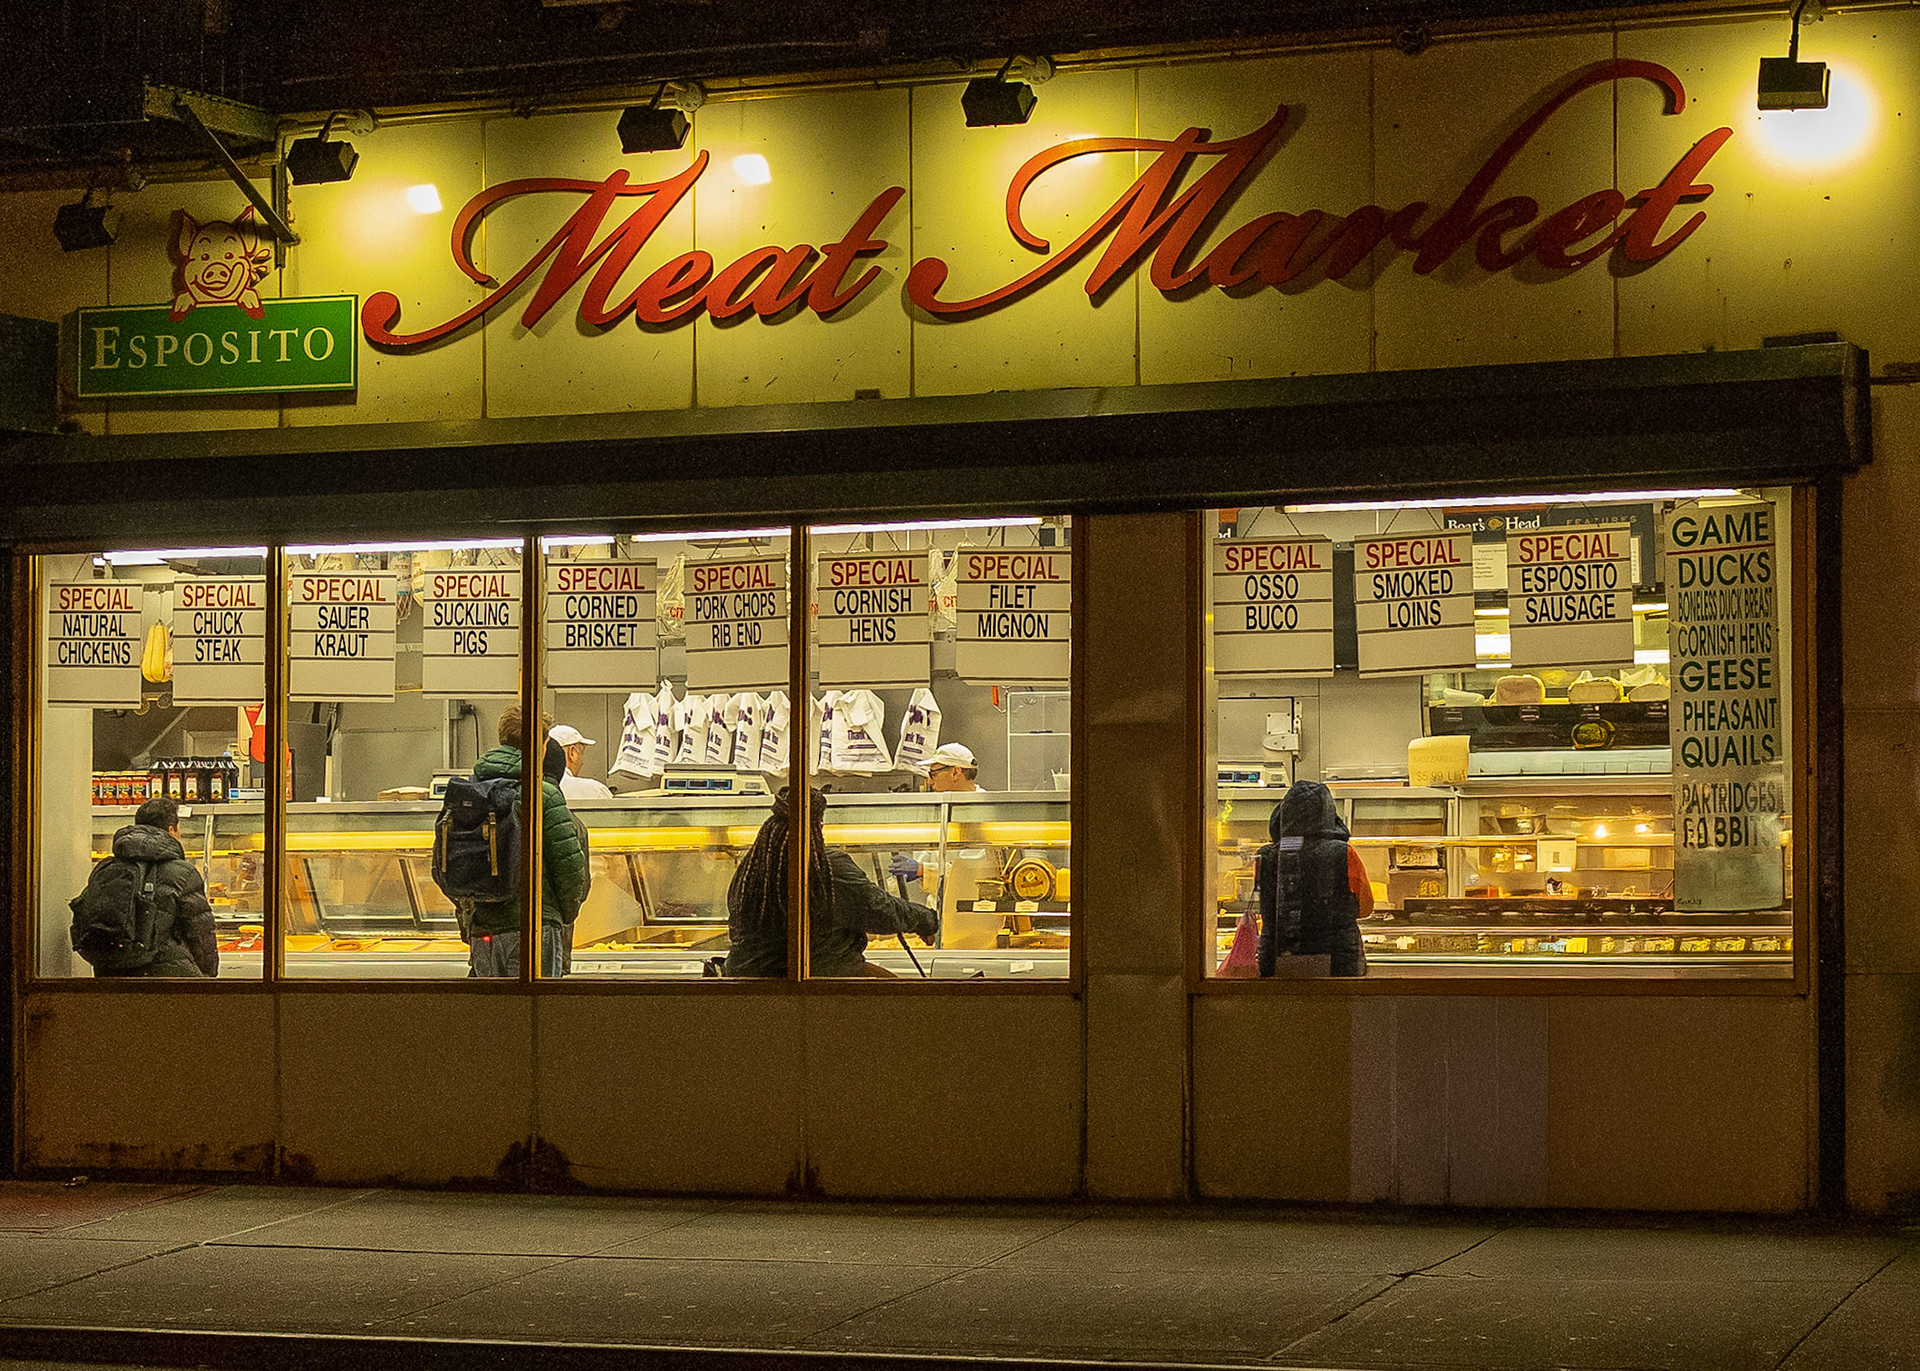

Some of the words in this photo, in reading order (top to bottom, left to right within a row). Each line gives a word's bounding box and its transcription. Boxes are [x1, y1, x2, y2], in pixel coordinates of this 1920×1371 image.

[362, 150, 906, 346] Meat
[906, 58, 1733, 314] Market
[90, 326, 335, 370] ESPOSITO
[1506, 515, 1540, 530] Head
[1672, 511, 1768, 547] GAME
[1225, 545, 1320, 571] SPECIAL
[1366, 539, 1460, 568] SPECIAL
[1519, 534, 1619, 564] SPECIAL
[558, 568, 645, 591] SPECIAL
[694, 564, 776, 592] SPECIAL
[830, 560, 920, 586] SPECIAL
[968, 556, 1059, 580] SPECIAL
[1522, 563, 1618, 593] ESPOSITO
[1678, 552, 1771, 588] DUCKS
[183, 585, 256, 606] SPECIAL
[302, 578, 386, 602] SPECIAL
[433, 575, 510, 598] SPECIAL
[990, 584, 1036, 609] FILET
[1245, 574, 1298, 600] OSSO
[1373, 570, 1453, 600] SMOKED
[60, 588, 133, 610] SPECIAL
[566, 596, 638, 619] CORNED
[696, 596, 728, 620] PORK
[734, 592, 776, 618] CHOPS
[834, 589, 912, 614] CORNISH
[1526, 594, 1616, 624] SAUSAGE
[1678, 590, 1717, 622] BONELESS
[1720, 588, 1742, 620] DUCK
[1744, 587, 1773, 618] BREAST
[63, 615, 126, 636] NATURAL
[194, 612, 243, 634] CHUCK
[318, 606, 369, 630] SAUER
[434, 602, 509, 626] SUCKLING
[978, 614, 1048, 638] MIGNON
[1246, 604, 1298, 630] BUCO
[1387, 600, 1442, 628] LOINS
[454, 630, 488, 654] PIGS
[566, 624, 637, 647] BRISKET
[712, 624, 731, 648] RIB
[738, 622, 762, 646] END
[850, 618, 896, 642] HENS
[1678, 624, 1735, 657] CORNISH
[1740, 622, 1772, 654] HENS
[58, 642, 130, 664] CHICKENS
[195, 639, 241, 662] STEAK
[314, 634, 368, 656] KRAUT
[1680, 658, 1771, 692] GEESE
[1683, 698, 1777, 732] PHEASANT
[1682, 734, 1774, 768] QUAILS
[1682, 782, 1776, 814] PARTRIDGES
